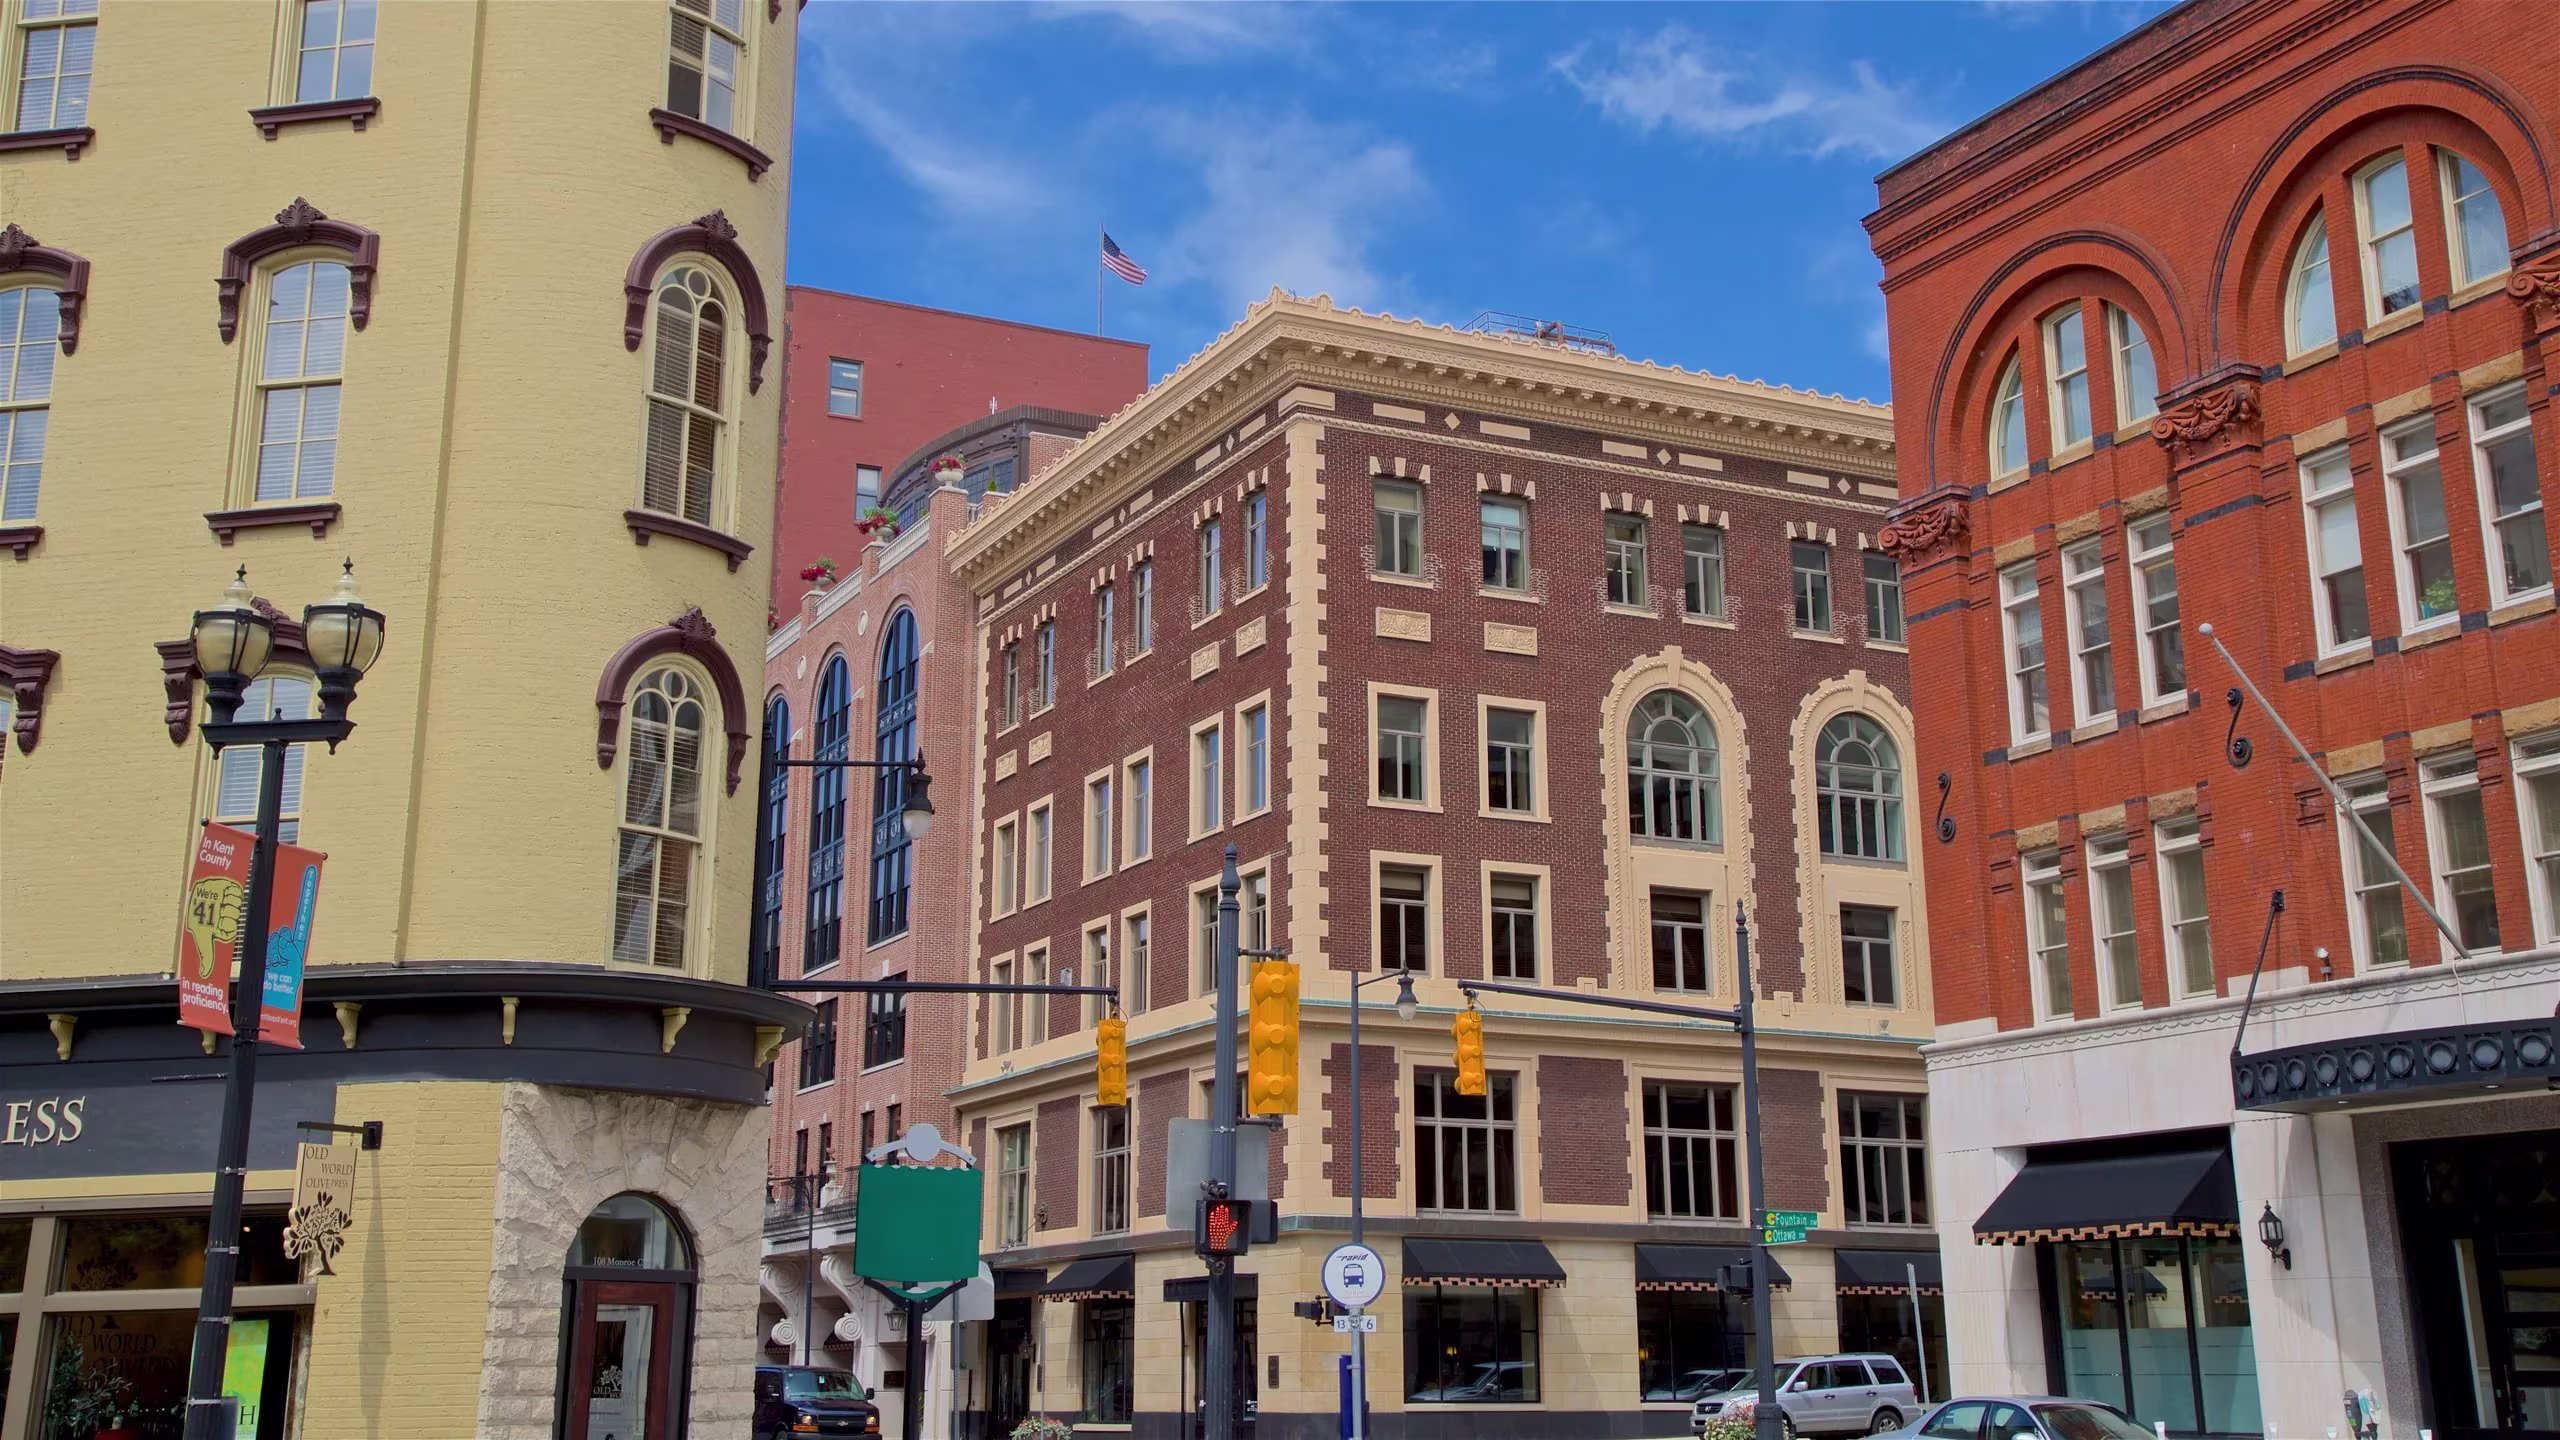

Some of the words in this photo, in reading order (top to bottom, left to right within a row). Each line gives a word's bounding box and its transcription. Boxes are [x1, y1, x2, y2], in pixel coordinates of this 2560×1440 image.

[202, 836, 212, 849] In
[213, 839, 235, 855] Kent
[199, 849, 232, 871] County
[196, 887, 219, 901] We're
[182, 976, 190, 990] in
[191, 981, 224, 1001] reading
[182, 993, 229, 1015] proficiency.
[0, 1095, 87, 1148] ESS
[305, 1146, 329, 1160] OLD
[321, 1163, 353, 1176] WORLD
[305, 1177, 330, 1189] OLIVE
[330, 1178, 349, 1188] PRESS
[1776, 1213, 1807, 1226] Fountain
[1773, 1229, 1797, 1242] Ottawa
[594, 1256, 606, 1266] 108
[607, 1257, 636, 1267] Monroe
[1341, 1253, 1369, 1262] rapid
[1336, 1320, 1345, 1329] 13
[1367, 1319, 1373, 1330] 6
[91, 1333, 157, 1354] WORLD
[593, 1386, 611, 1395] OLD
